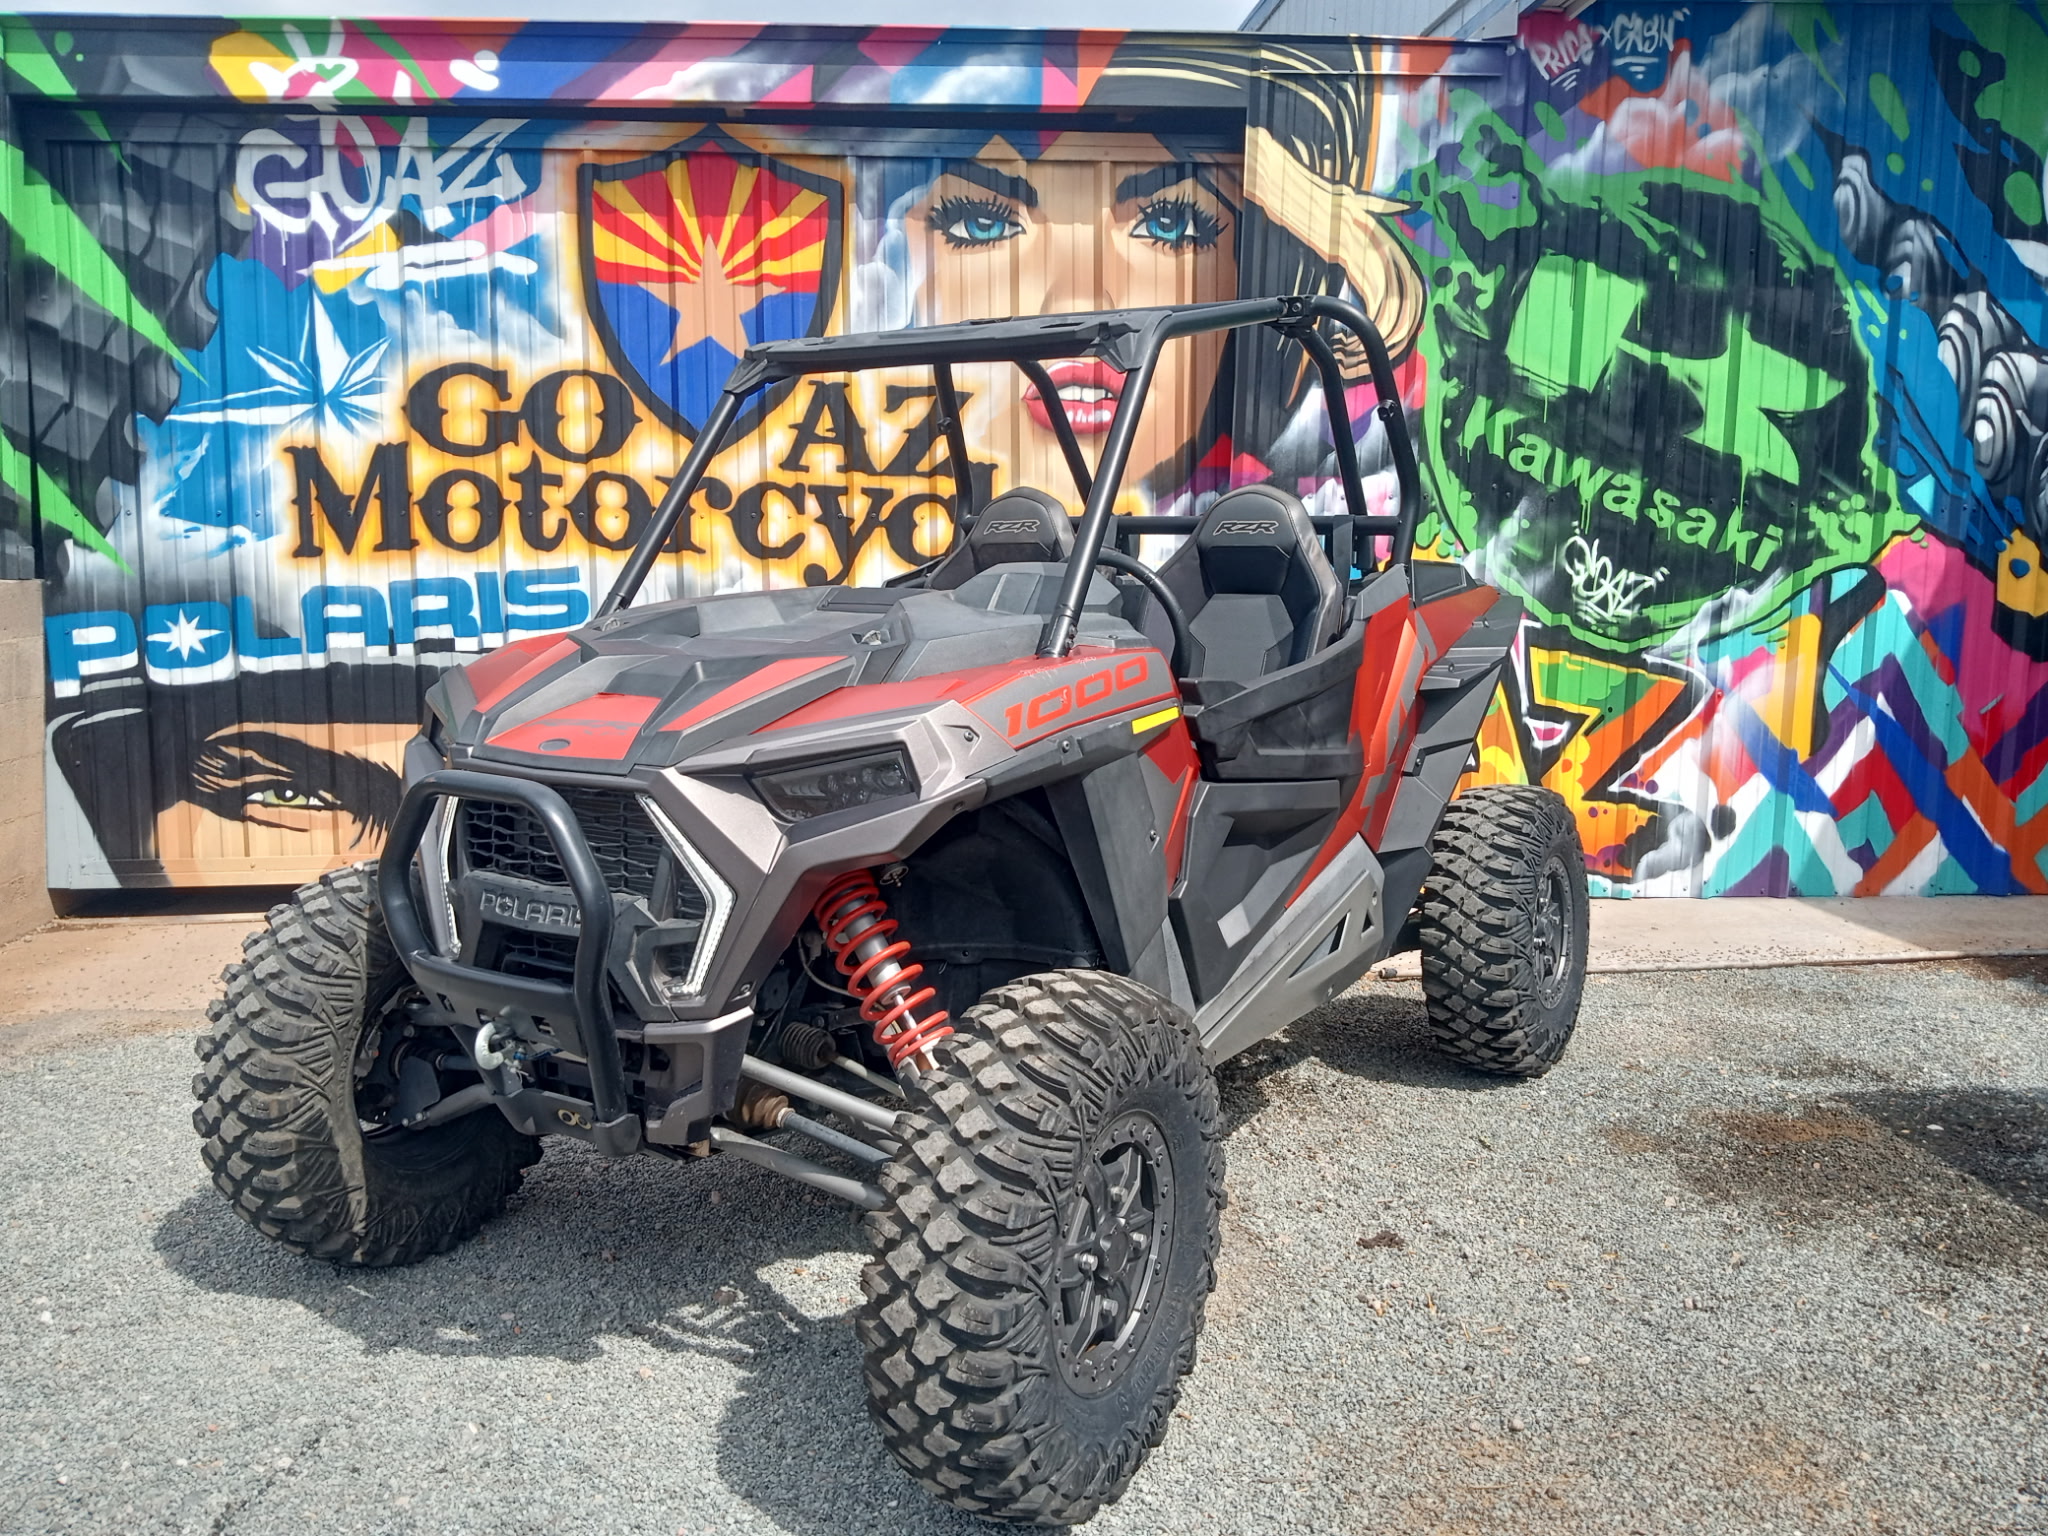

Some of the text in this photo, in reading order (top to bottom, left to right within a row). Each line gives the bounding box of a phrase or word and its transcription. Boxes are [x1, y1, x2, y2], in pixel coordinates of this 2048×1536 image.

[401, 361, 974, 476] GO AZ
[984, 519, 1041, 535] RZR
[1213, 520, 1279, 536] RZR
[1456, 395, 1784, 572] Kawasaki
[44, 565, 592, 699] POLARIS
[1004, 655, 1149, 738] 1000
